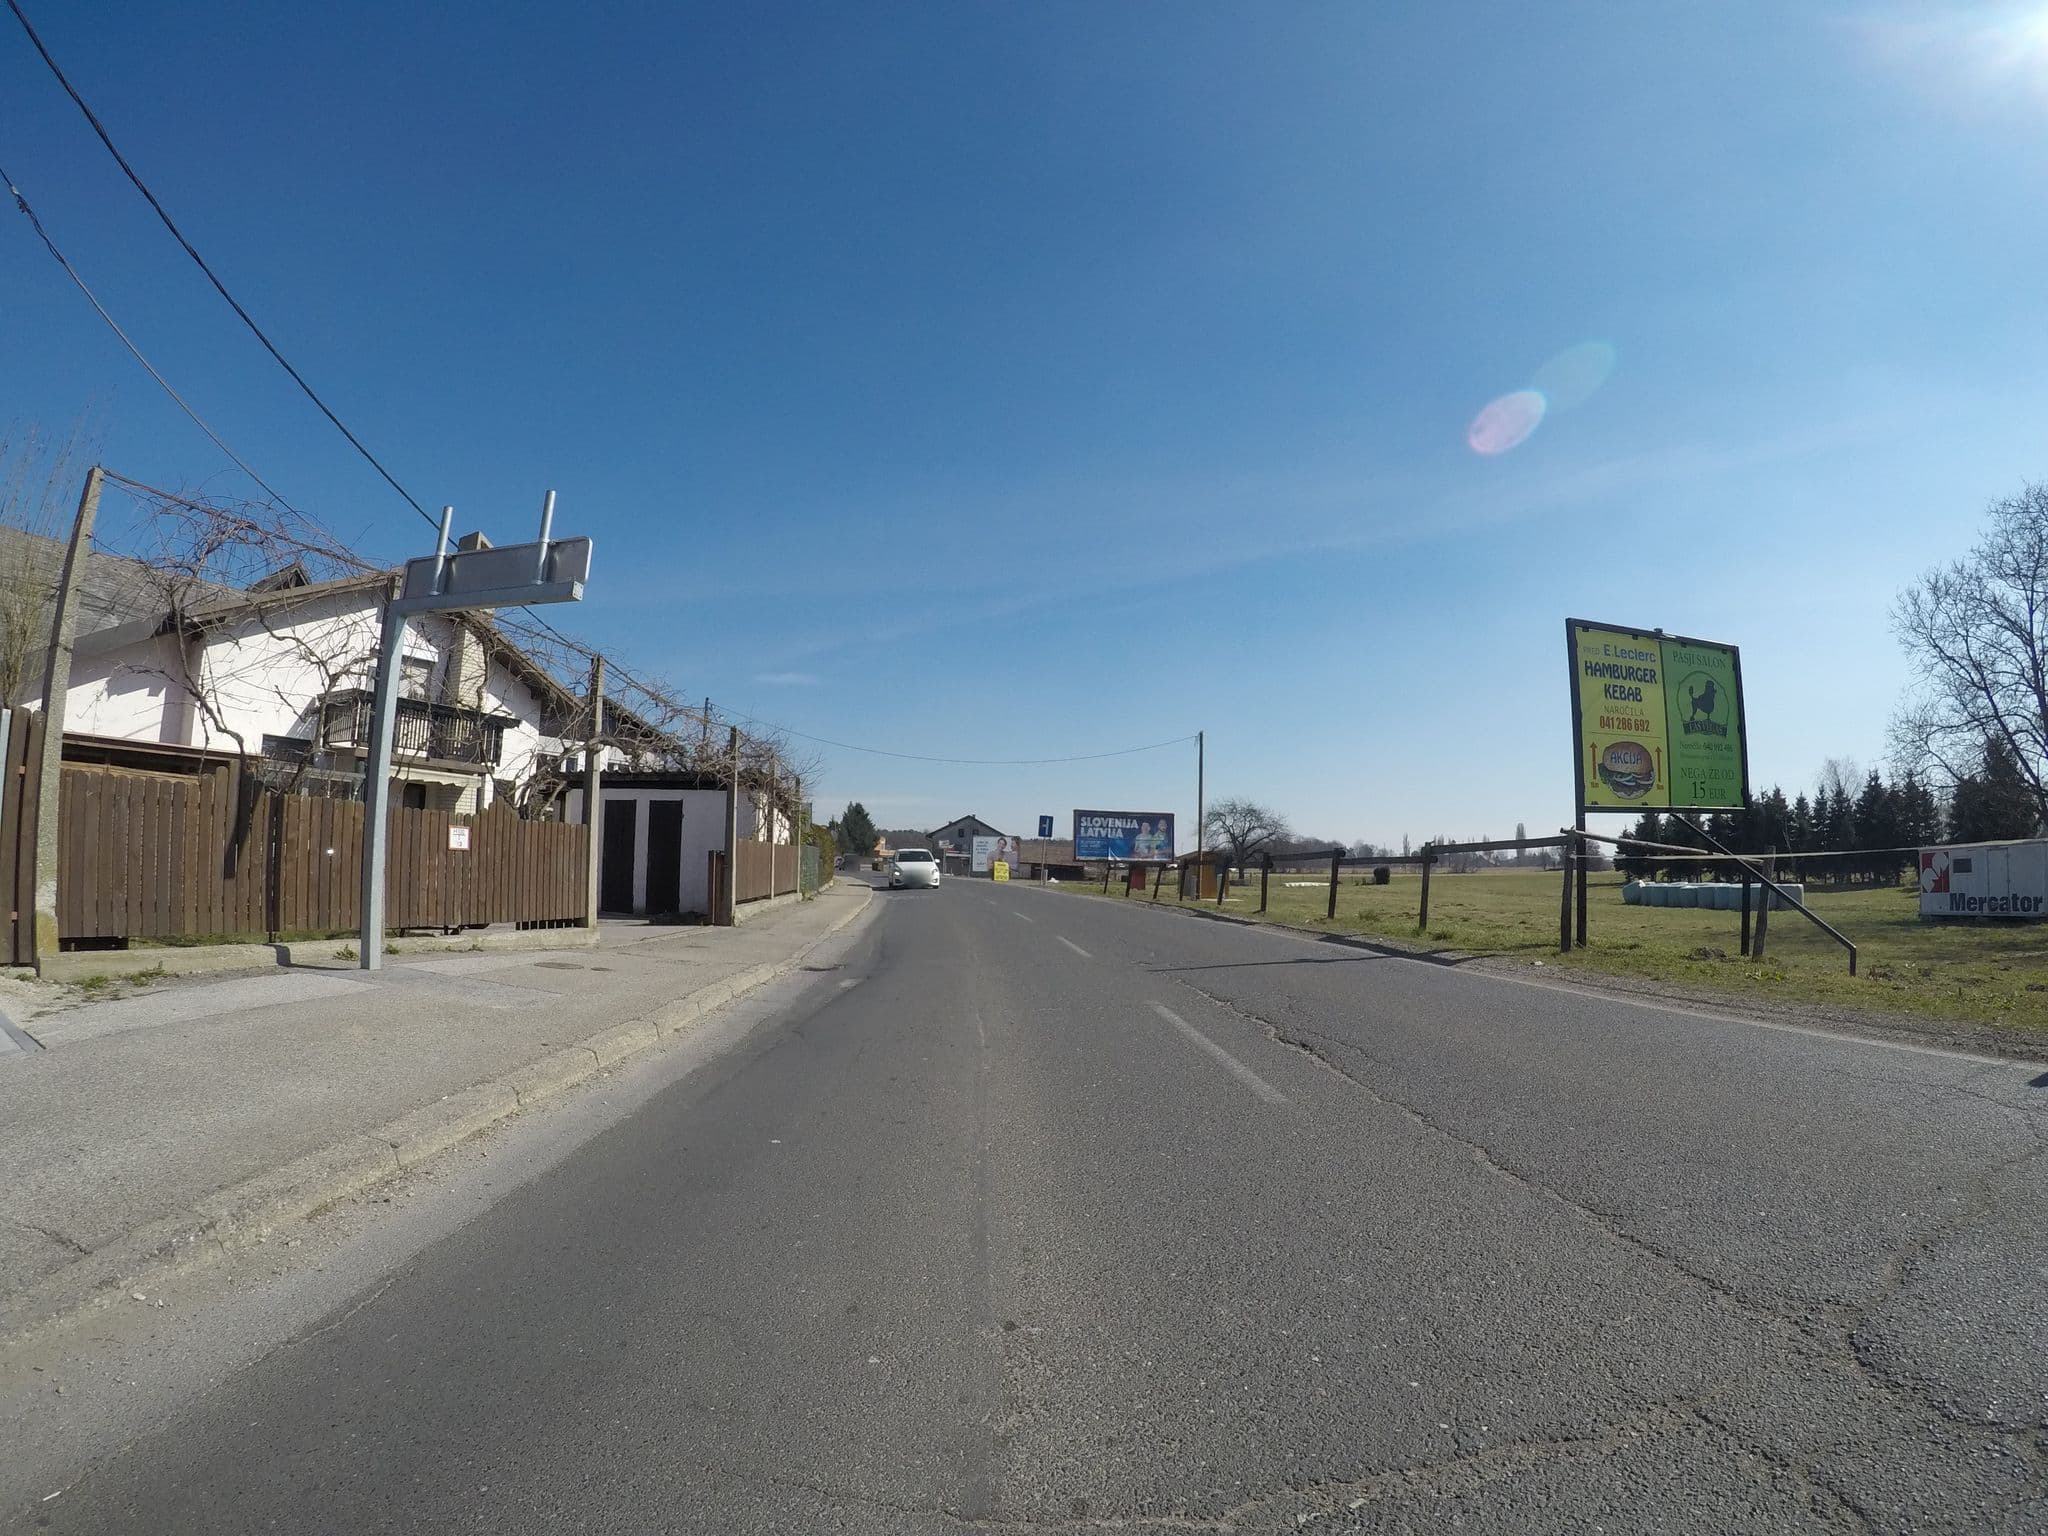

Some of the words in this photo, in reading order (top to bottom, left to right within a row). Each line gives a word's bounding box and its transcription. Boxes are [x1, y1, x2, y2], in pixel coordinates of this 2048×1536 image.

[1604, 643, 1656, 662] E.Leclerc
[1697, 655, 1727, 669] SALON
[1584, 660, 1657, 684] HAMBURGER
[1604, 683, 1643, 702] KEBAB
[1600, 715, 1614, 730] 041
[1616, 717, 1632, 731] 286
[1634, 718, 1650, 733] 692
[1611, 751, 1642, 765] AKCIJA
[1680, 767, 1706, 780] NEGA
[1692, 781, 1706, 799] 15
[1709, 788, 1727, 800] EUR
[1080, 816, 1139, 829] SLOVENIJA
[1080, 827, 1123, 838] LATVIJA
[1949, 892, 2043, 913] Mercator
